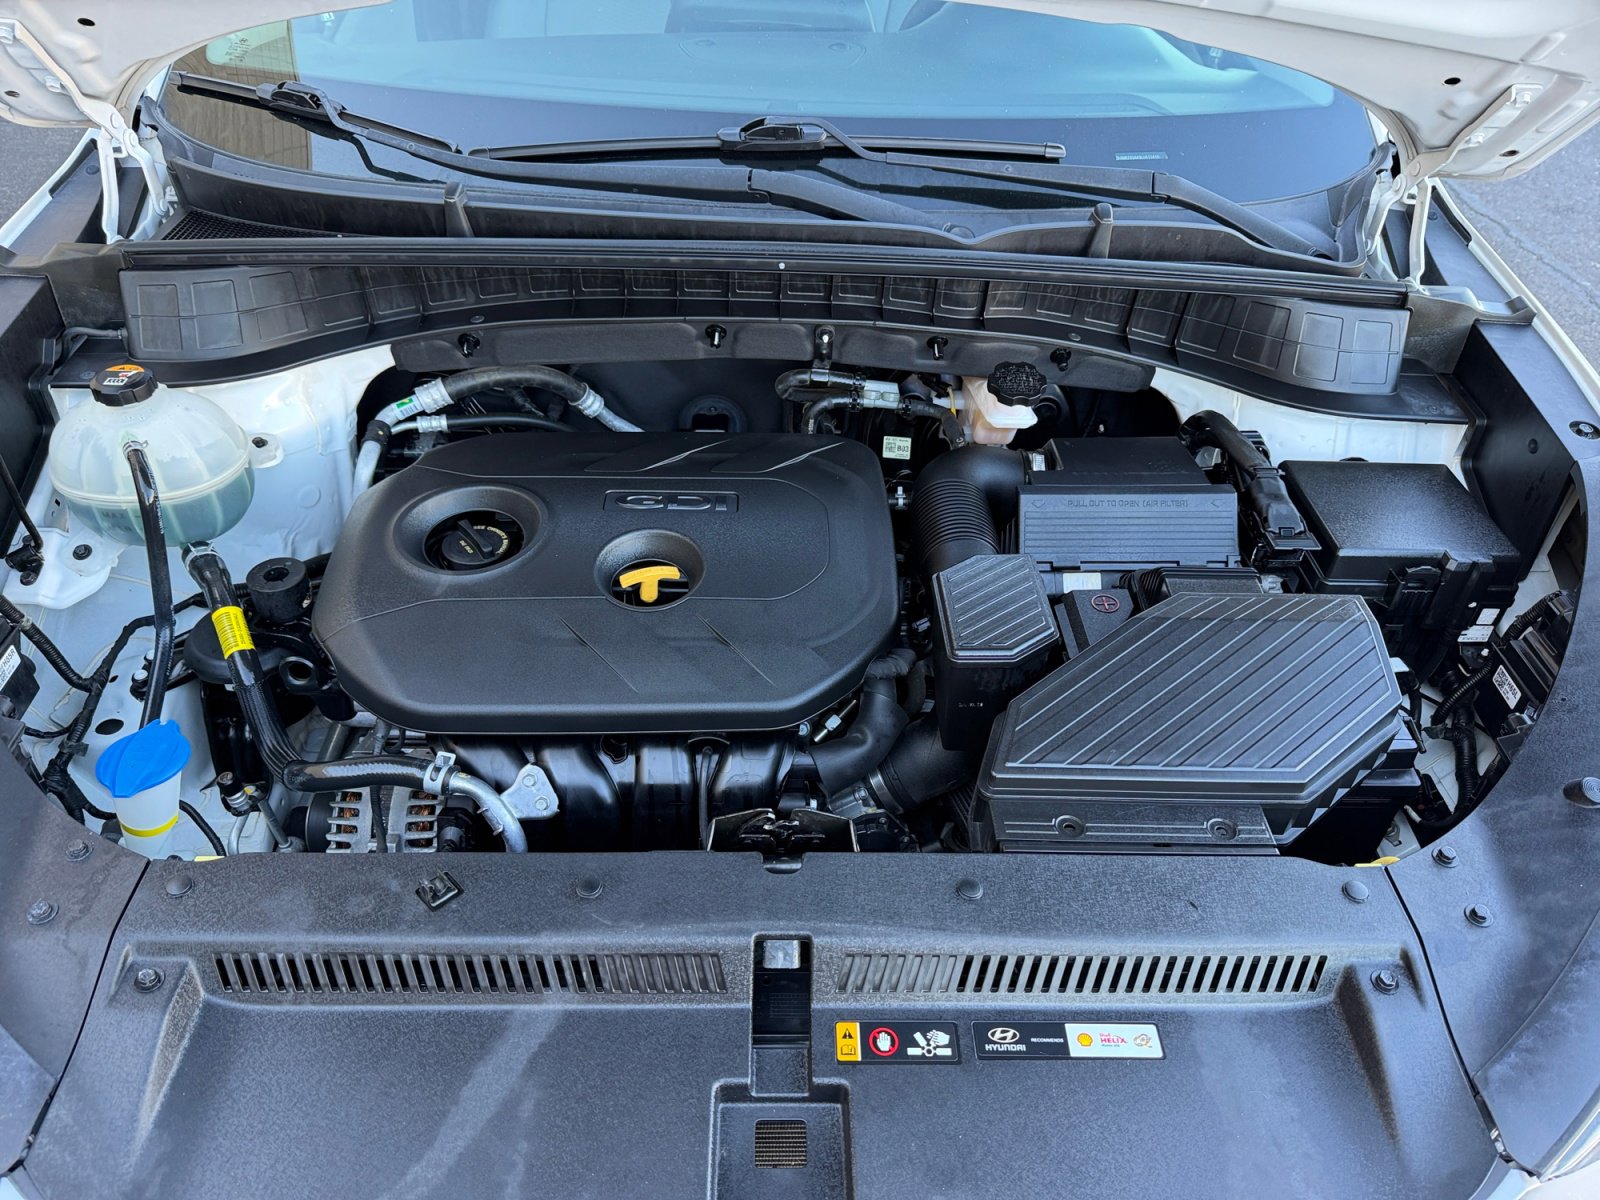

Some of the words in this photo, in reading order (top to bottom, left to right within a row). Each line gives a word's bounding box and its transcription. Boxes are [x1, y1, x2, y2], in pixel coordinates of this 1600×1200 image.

[1068, 499, 1087, 507] PULL
[1106, 499, 1116, 507] TO
[1119, 499, 1139, 508] OPEN
[985, 1043, 1026, 1052] HYUNDAI
